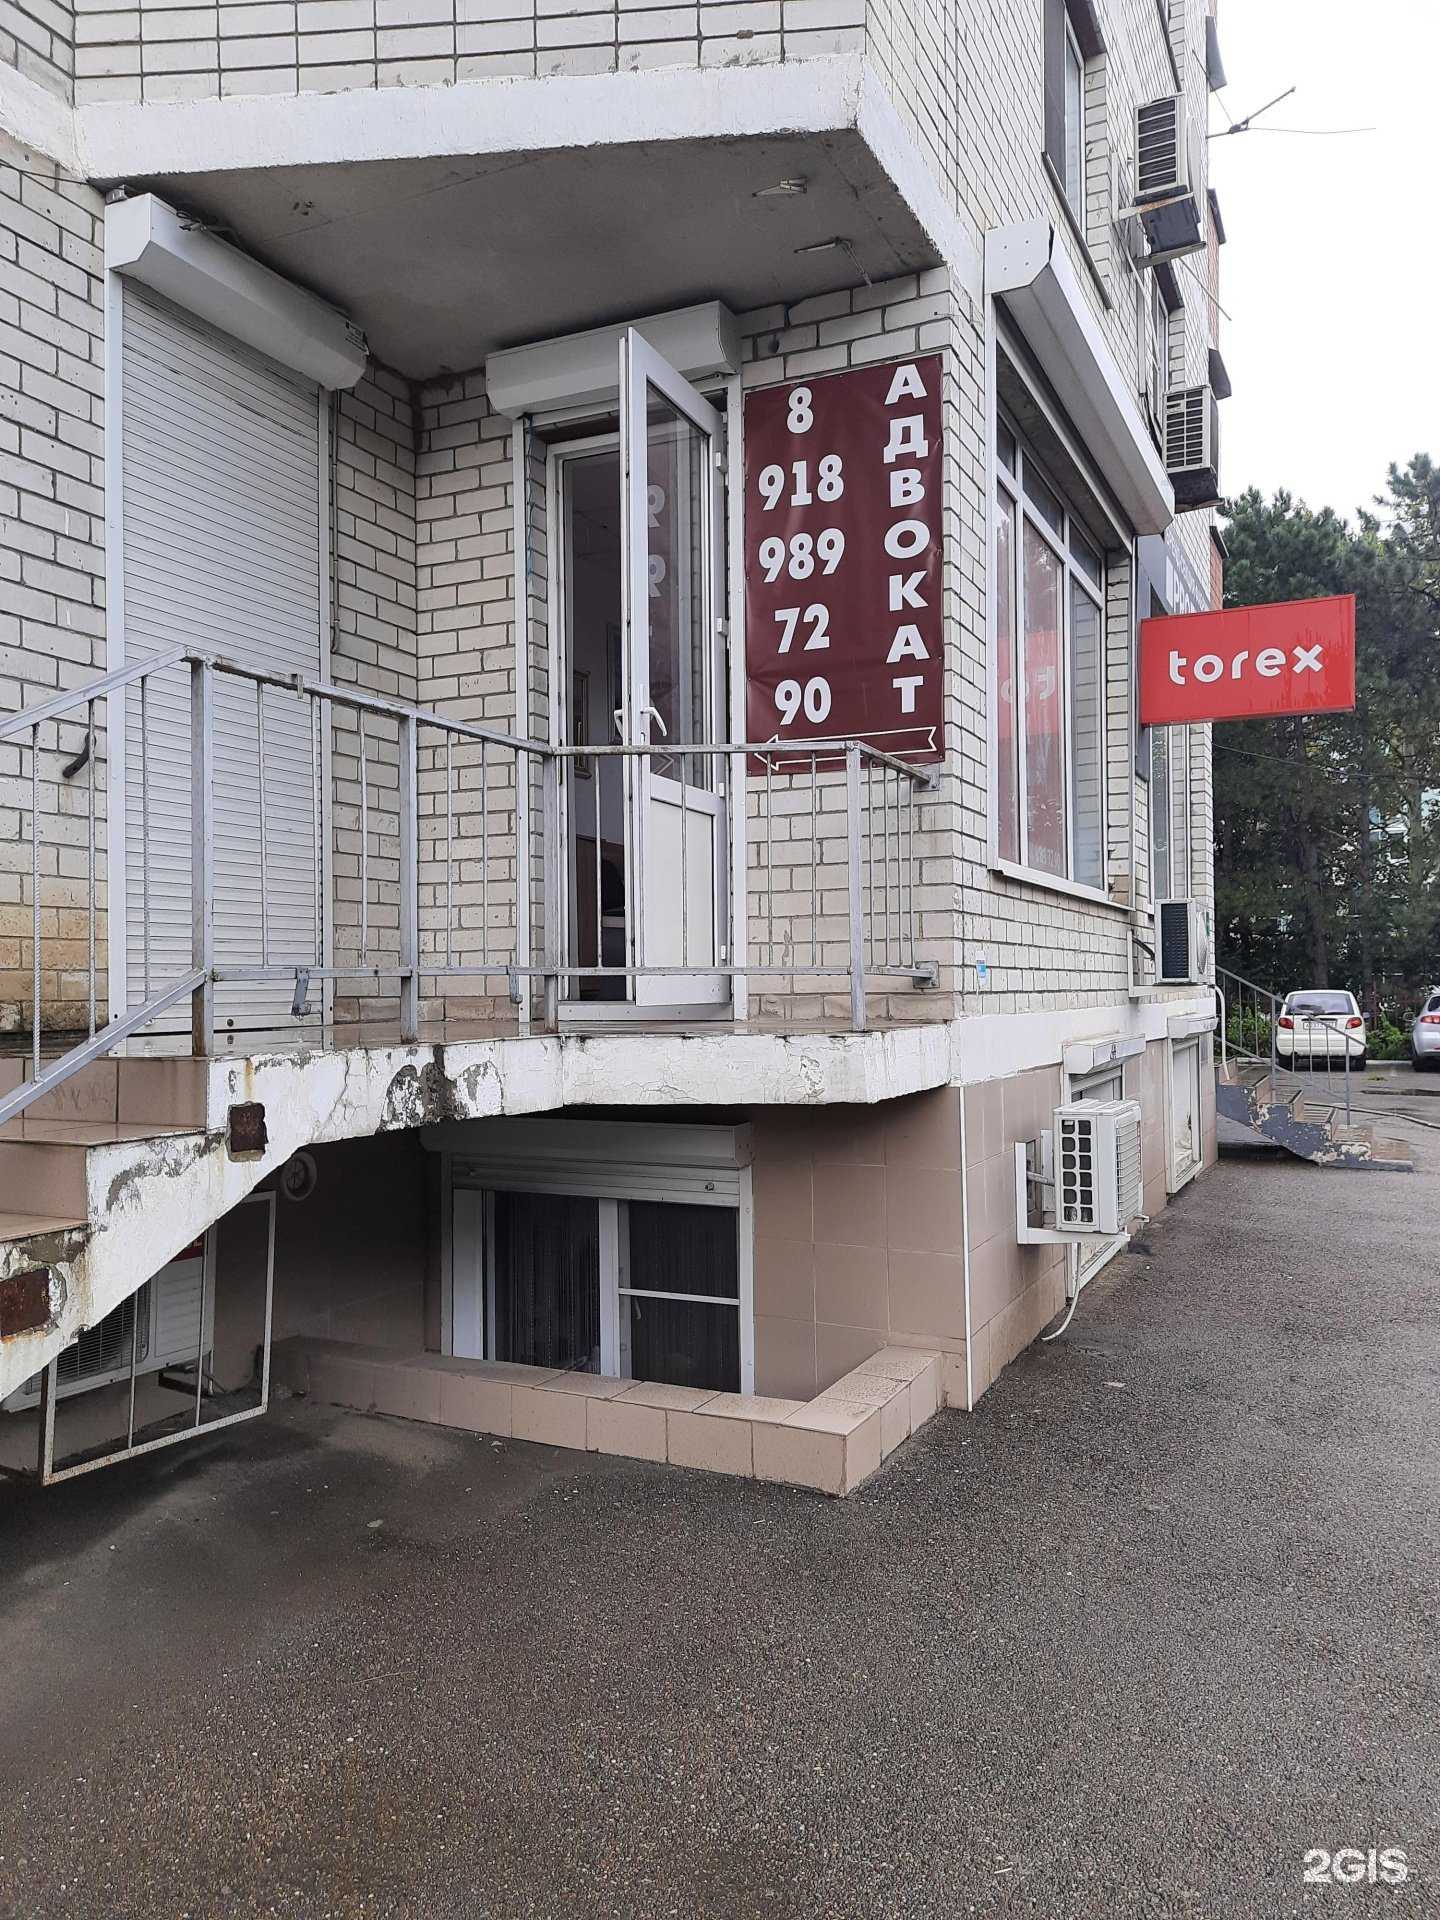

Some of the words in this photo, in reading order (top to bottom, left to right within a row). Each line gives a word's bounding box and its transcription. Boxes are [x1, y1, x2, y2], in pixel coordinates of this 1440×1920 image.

[787, 386, 814, 434] 8
[758, 454, 844, 511] 918
[758, 528, 845, 583] 989
[883, 364, 931, 714] АДВОКАТ
[774, 603, 830, 654] 72
[1169, 644, 1323, 685] torex
[774, 676, 831, 726] 90
